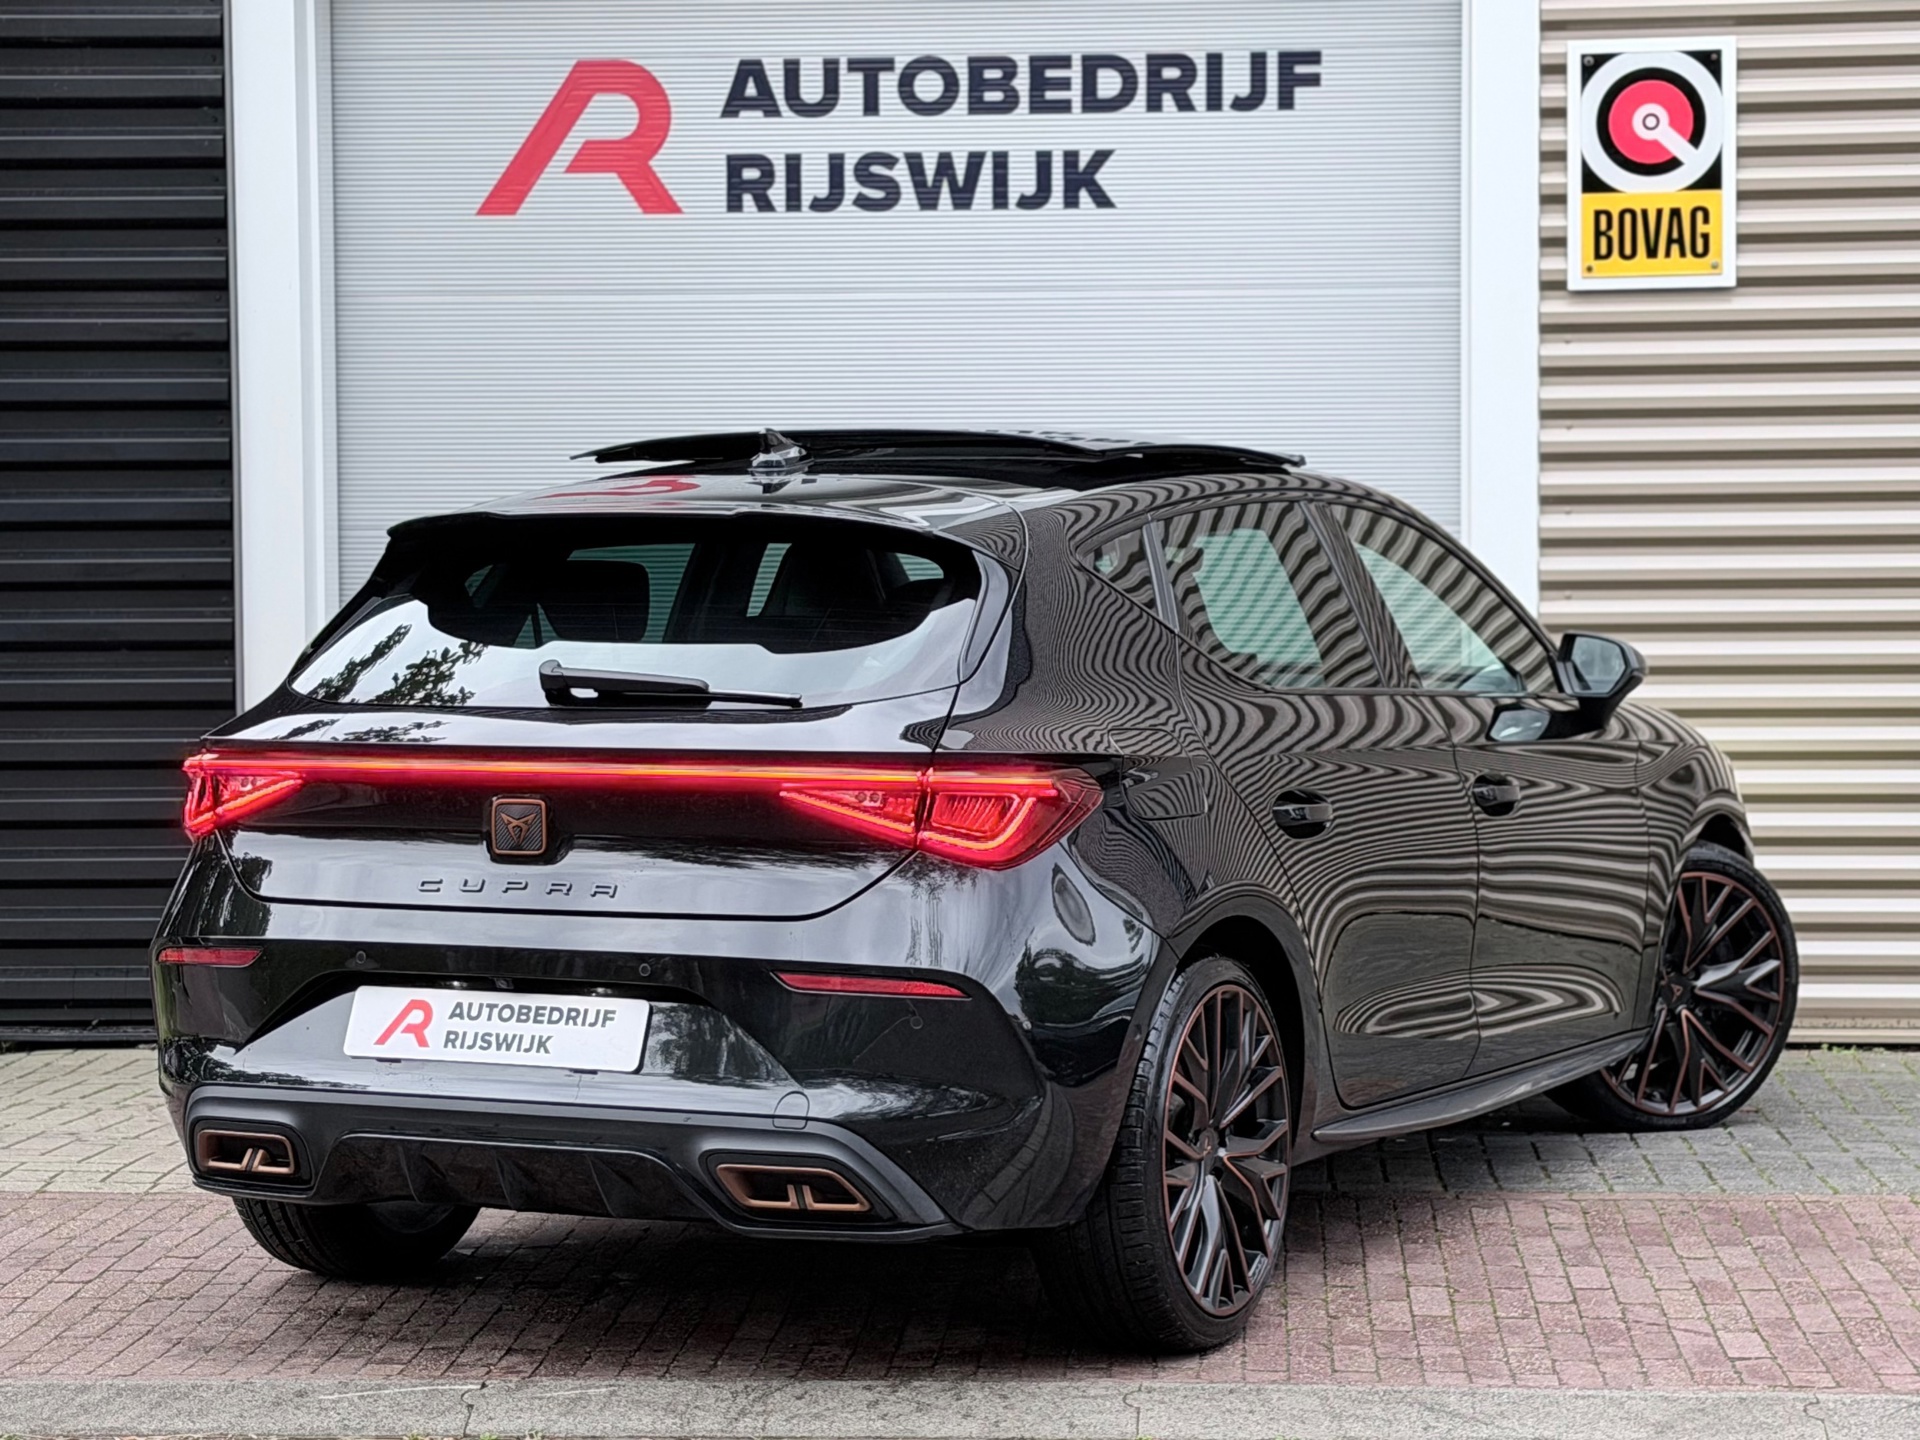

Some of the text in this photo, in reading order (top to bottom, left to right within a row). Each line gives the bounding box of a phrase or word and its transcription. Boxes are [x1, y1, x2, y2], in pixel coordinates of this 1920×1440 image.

[720, 50, 1323, 119] AUTOBEDRIJF
[725, 149, 1118, 213] RIJSWIJK
[1593, 205, 1711, 261] BOVAG
[417, 877, 619, 899] CUPRA
[447, 1000, 617, 1028] AUTOBEDRIJF
[442, 1030, 555, 1055] RIJSWIJK
